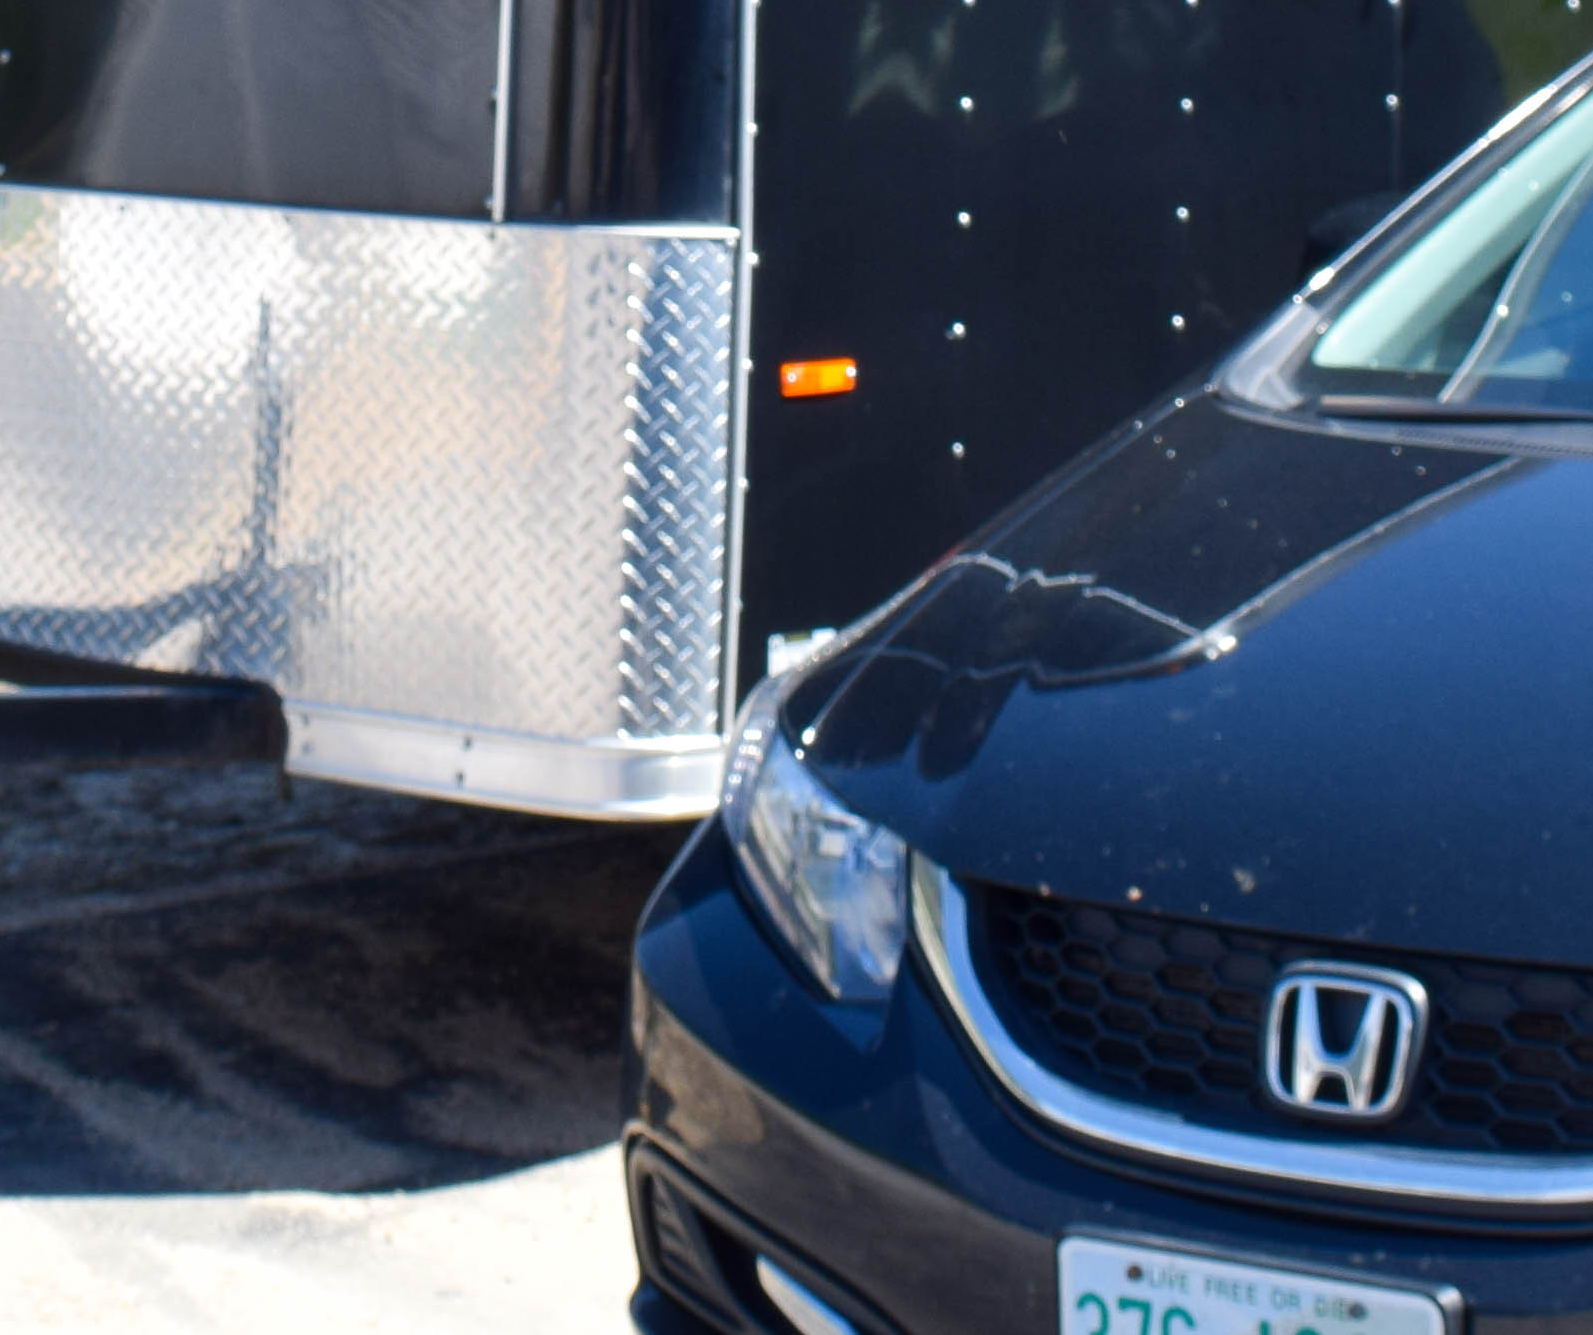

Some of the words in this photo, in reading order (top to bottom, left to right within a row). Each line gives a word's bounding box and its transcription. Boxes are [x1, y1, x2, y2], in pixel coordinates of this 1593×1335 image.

[1145, 1269, 1190, 1293] LIVE
[1206, 1277, 1255, 1304] FREE
[1270, 1288, 1301, 1310] OR
[1314, 1293, 1348, 1319] DIE
